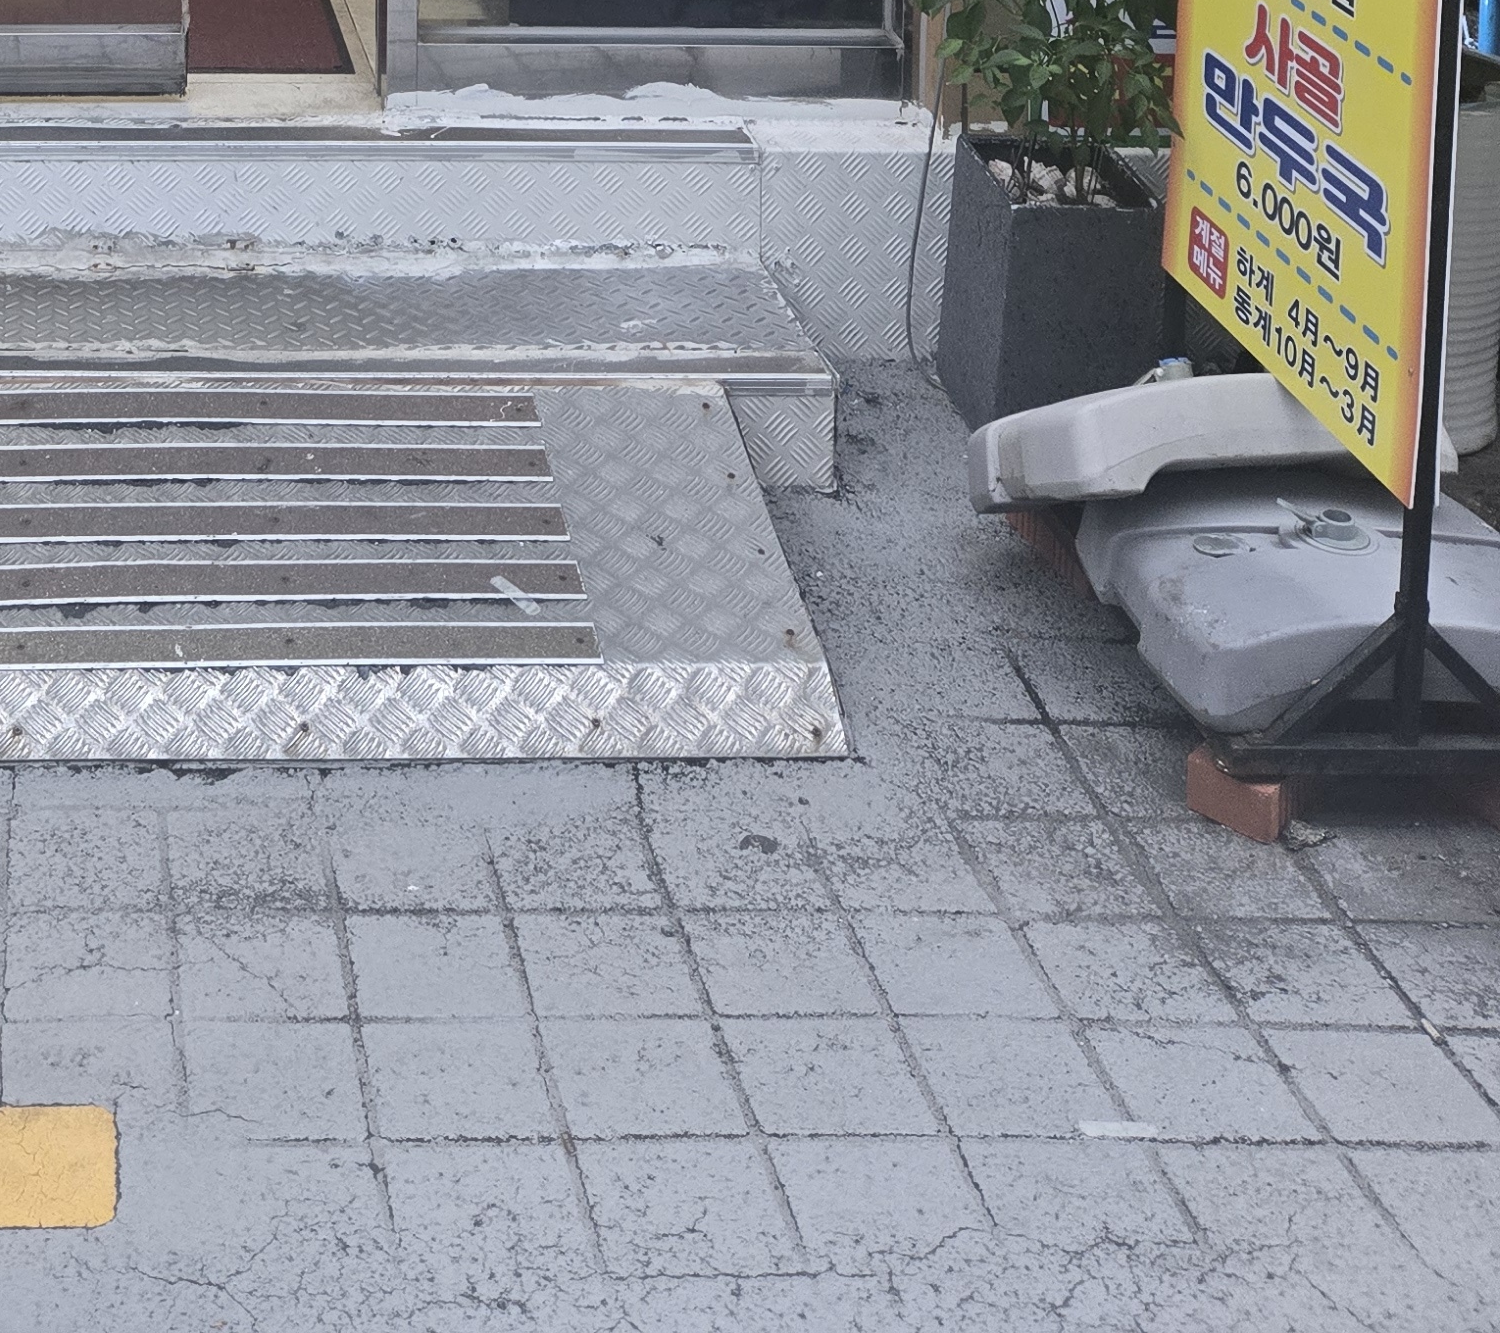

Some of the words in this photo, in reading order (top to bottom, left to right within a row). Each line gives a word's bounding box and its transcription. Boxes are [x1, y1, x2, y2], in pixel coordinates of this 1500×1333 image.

[1245, 2, 1345, 135] 사골
[1203, 49, 1392, 266] 만두국
[1193, 213, 1226, 258] 계절
[1236, 161, 1341, 282] 6.000원
[1191, 245, 1224, 293] 메뉴
[1236, 247, 1275, 308] 하계
